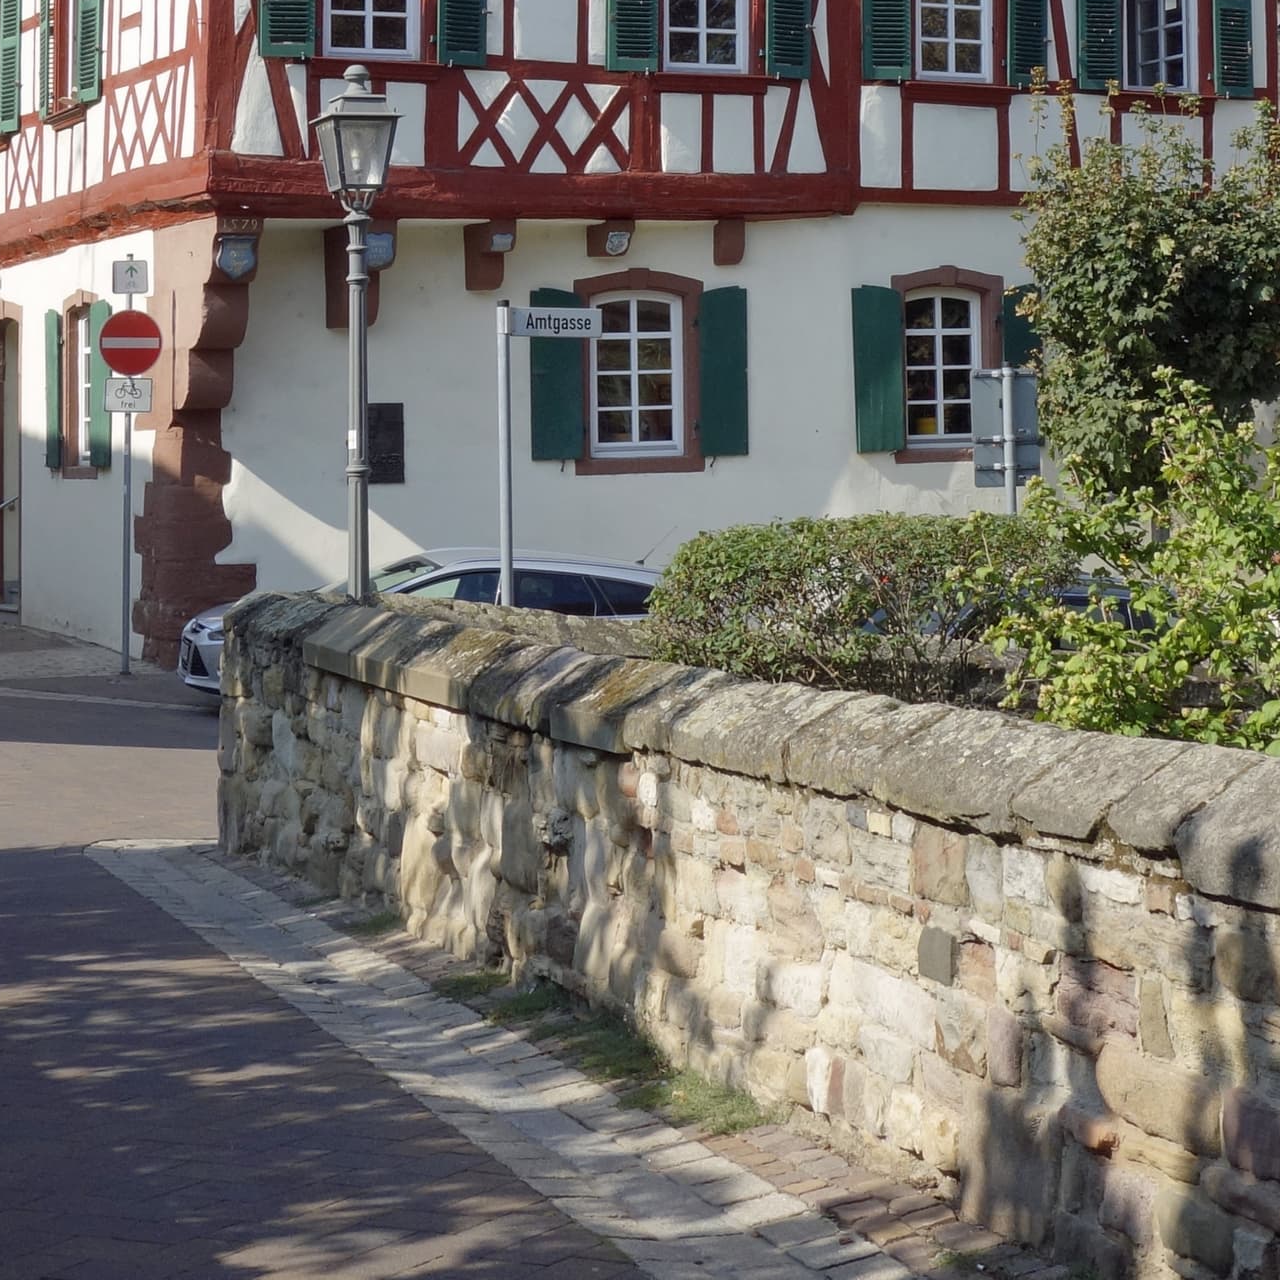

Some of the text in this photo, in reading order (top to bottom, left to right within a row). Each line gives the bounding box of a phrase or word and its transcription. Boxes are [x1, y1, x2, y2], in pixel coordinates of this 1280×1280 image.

[223, 218, 258, 230] 1579
[526, 312, 592, 335] Amtgasse
[120, 400, 136, 409] frei
